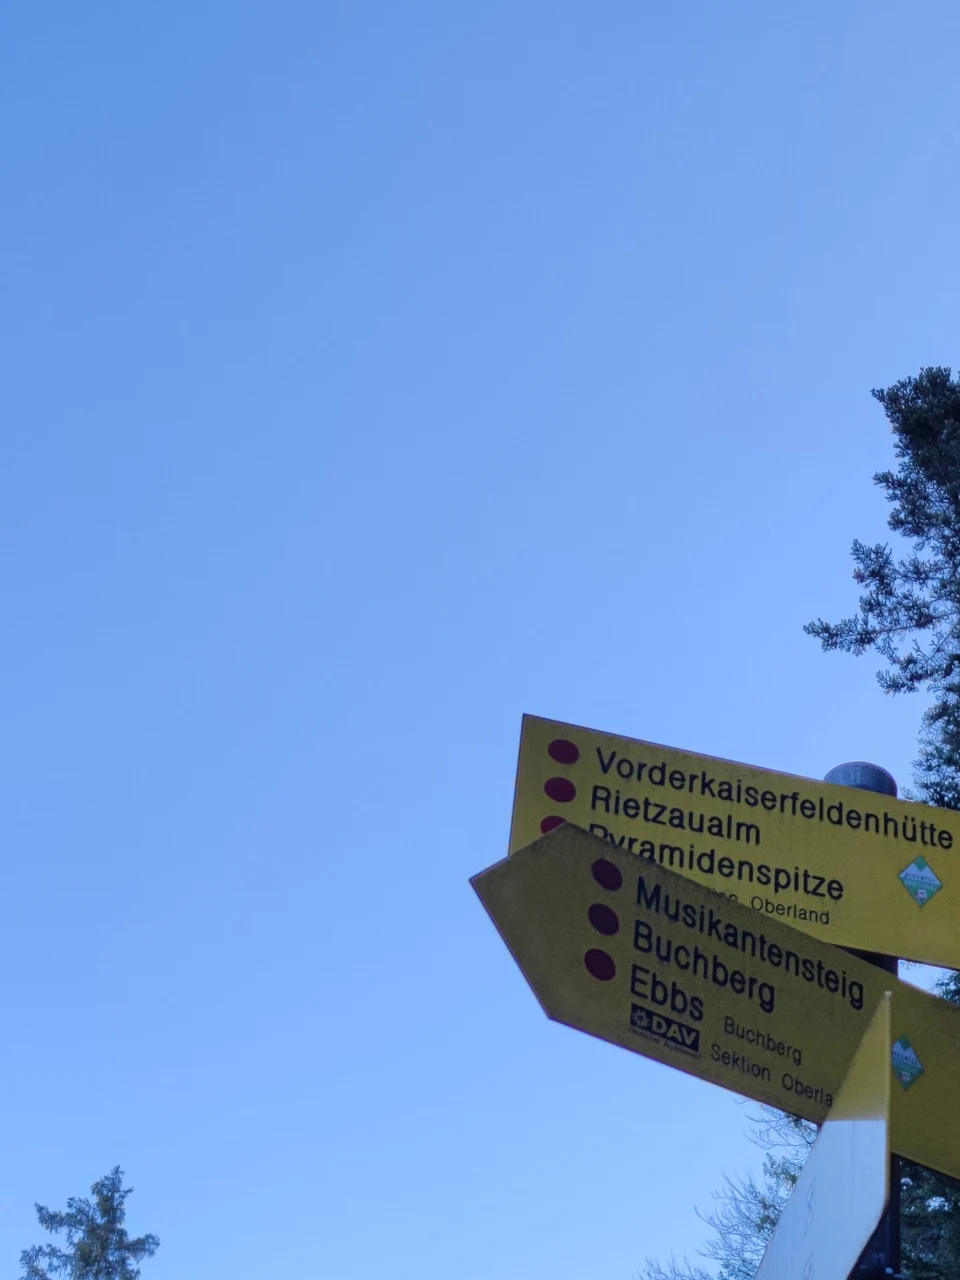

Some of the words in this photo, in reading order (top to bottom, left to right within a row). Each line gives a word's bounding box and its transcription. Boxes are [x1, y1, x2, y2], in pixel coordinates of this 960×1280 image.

[591, 785, 761, 846] Rietzaualm
[596, 746, 954, 850] Vorderkaiserfeldenhütte
[751, 896, 830, 925] Oberland
[633, 919, 775, 1014] Buchberg
[636, 876, 864, 1011] Musikantensteig
[630, 964, 704, 1022] Ebbs
[652, 1016, 698, 1047] DAV
[723, 1016, 803, 1066] Buchberg
[710, 1043, 772, 1083] Sektion
[782, 1073, 834, 1108] Oberla
